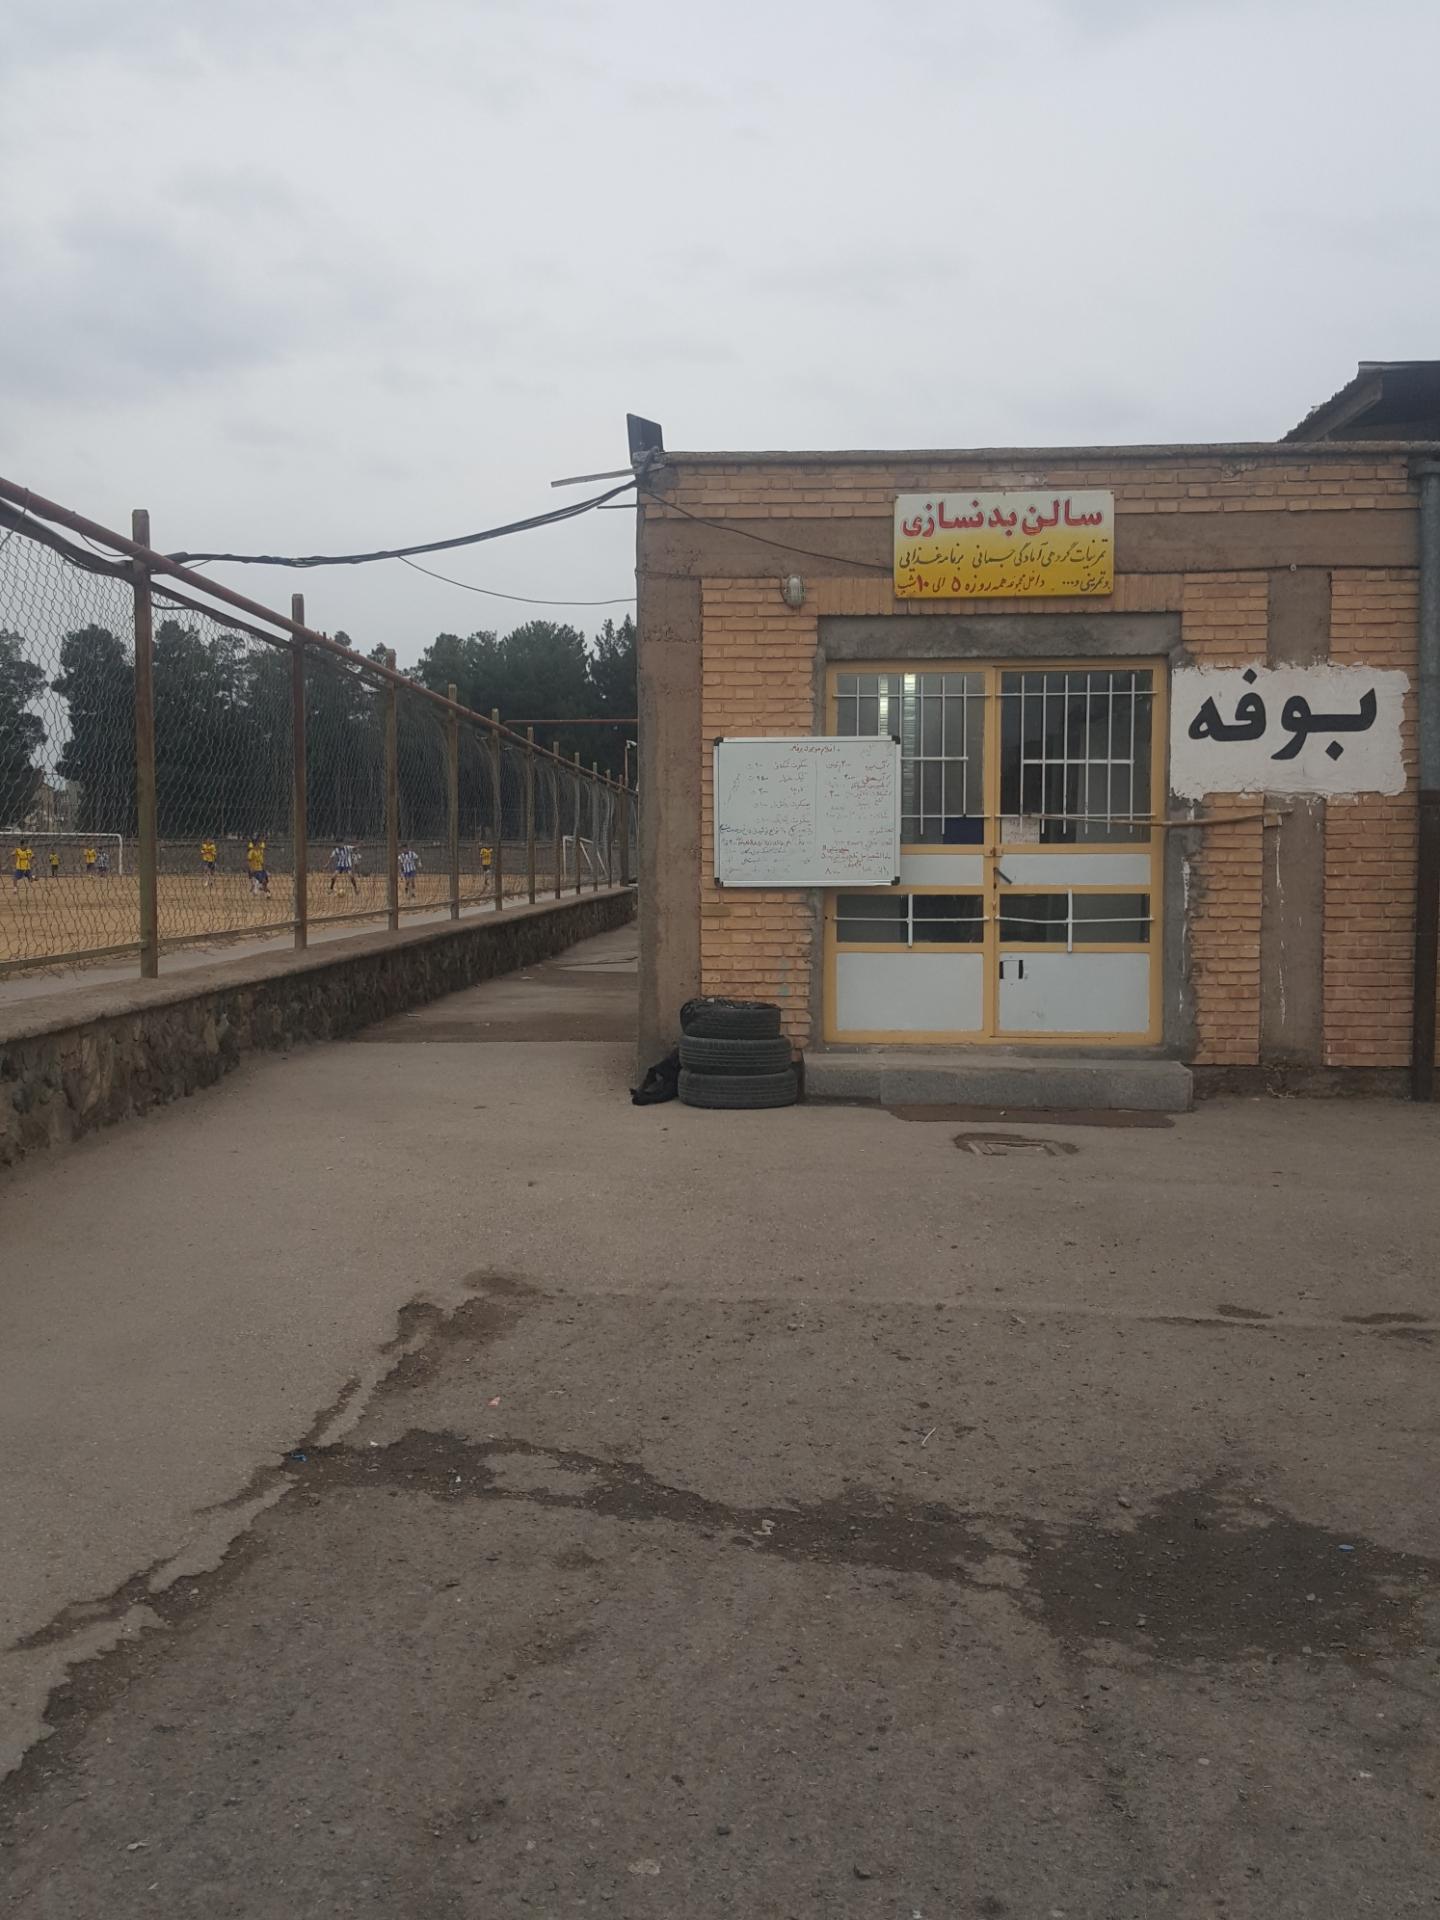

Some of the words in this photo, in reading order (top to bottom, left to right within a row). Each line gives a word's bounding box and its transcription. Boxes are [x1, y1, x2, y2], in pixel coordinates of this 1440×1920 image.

[902, 499, 1018, 537] بدنسازی
[1022, 498, 1103, 536] سالن
[938, 543, 964, 571] برنامه
[972, 544, 1015, 568] جسمانی
[1014, 541, 1048, 566] آمادگی
[1041, 542, 1079, 567] گروهی
[1070, 539, 1108, 569] تمرینات
[932, 577, 946, 592] الی
[951, 576, 961, 592] ۵
[1188, 668, 1377, 761] بوفه
